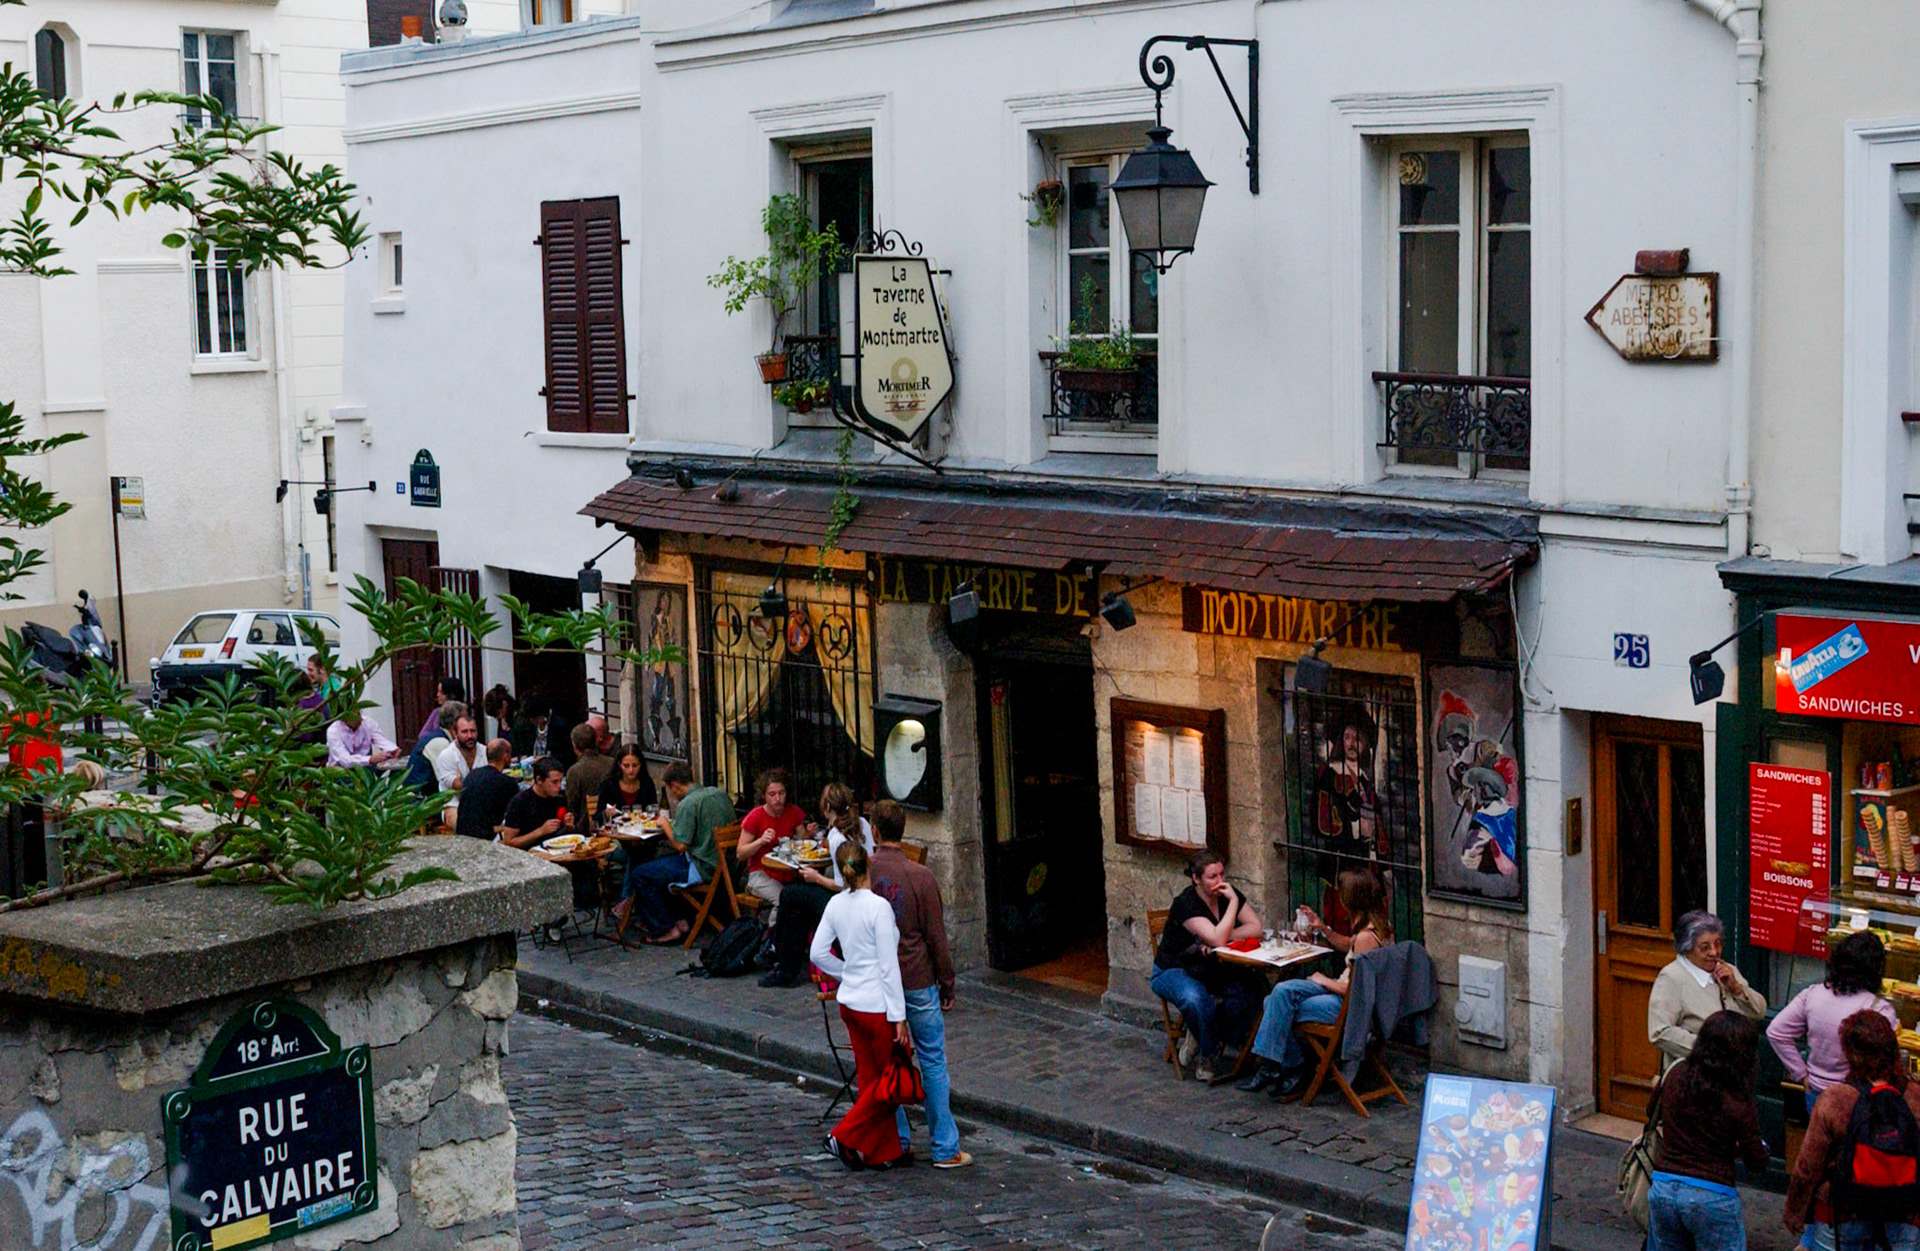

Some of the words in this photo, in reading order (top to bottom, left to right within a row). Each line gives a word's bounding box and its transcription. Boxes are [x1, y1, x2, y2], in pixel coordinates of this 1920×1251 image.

[892, 265, 907, 283] La
[873, 287, 925, 304] Taverne
[893, 307, 907, 327] de
[1611, 306, 1699, 326] ABBESSES
[861, 327, 940, 349] Montmartre
[878, 375, 931, 393] MORTIMER
[878, 560, 909, 602] LA
[924, 562, 1039, 613] TAVERNE
[1054, 572, 1091, 618] DE
[1201, 590, 1403, 652] MONTMARTRE
[1615, 635, 1647, 666] 25
[1798, 694, 1903, 718] SANDWICHES
[1757, 768, 1822, 786] SANDWICHES
[1763, 871, 1814, 890] BOISSONS
[239, 1092, 309, 1145] RUE
[264, 1142, 289, 1166] DU
[200, 1151, 355, 1228] CALVAIRE
